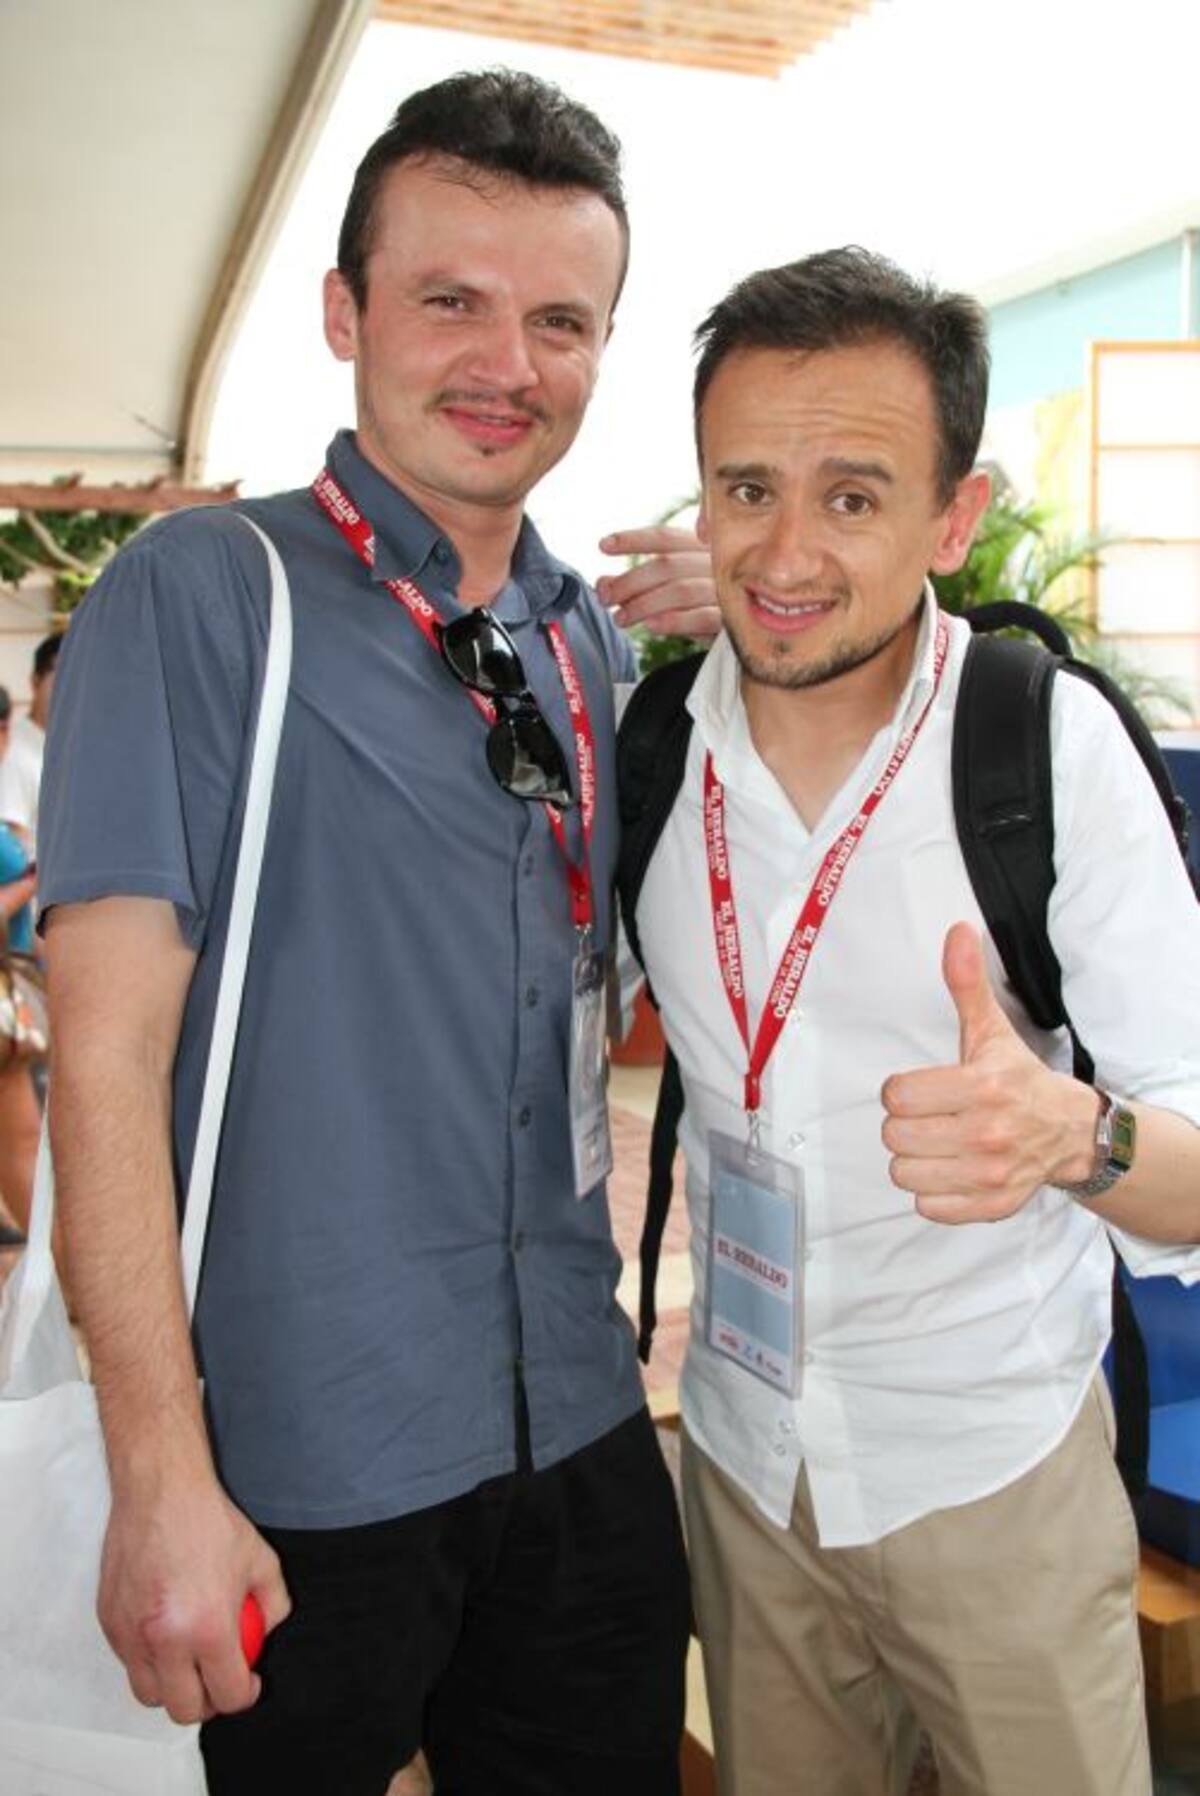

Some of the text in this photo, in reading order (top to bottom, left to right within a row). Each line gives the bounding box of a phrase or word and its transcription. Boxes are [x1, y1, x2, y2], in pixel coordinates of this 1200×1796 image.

[711, 786, 722, 808] EL
[712, 808, 727, 879] HERALDO
[818, 836, 858, 907] HERALDO
[720, 900, 734, 922] EL
[722, 924, 743, 998] HERALDO
[774, 925, 818, 1018] EL HERALDO
[718, 1239, 731, 1257] EL
[734, 1246, 788, 1289] HERALDO
